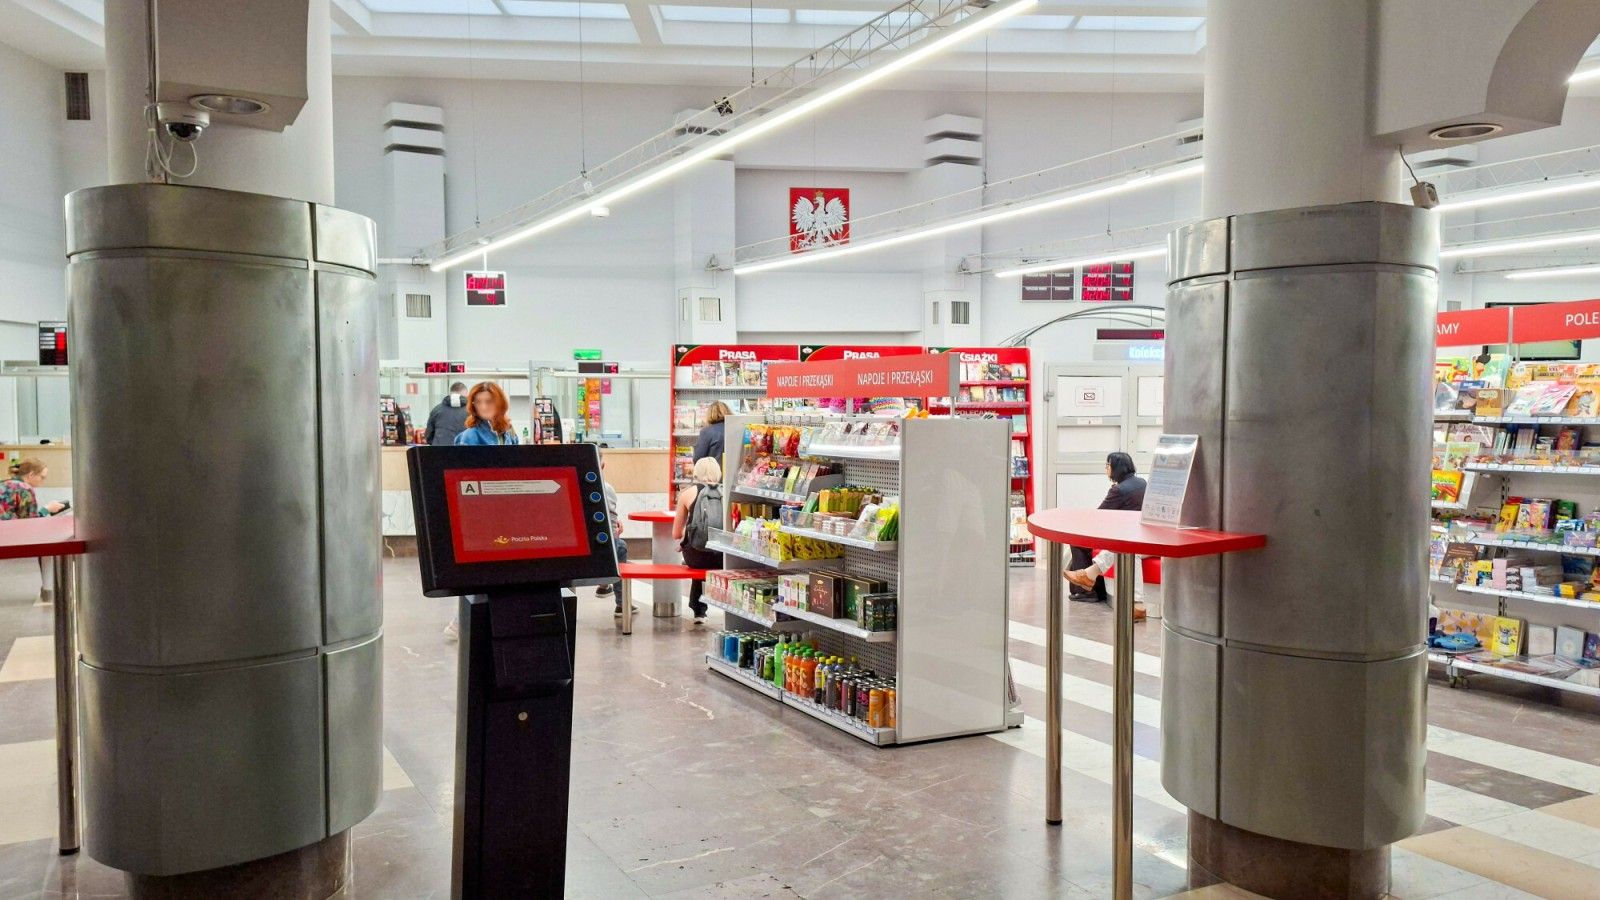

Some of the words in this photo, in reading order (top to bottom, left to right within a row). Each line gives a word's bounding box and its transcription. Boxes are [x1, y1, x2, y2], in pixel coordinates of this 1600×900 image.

[1565, 311, 1600, 327] POLE
[719, 349, 757, 360] PRASA
[776, 374, 798, 387] NAPOJE
[802, 373, 834, 388] PRZEKĄSKI
[857, 371, 884, 386] NAPOJE
[887, 371, 890, 385] I
[891, 369, 933, 387] PRZEKĄSKI
[465, 483, 475, 493] A
